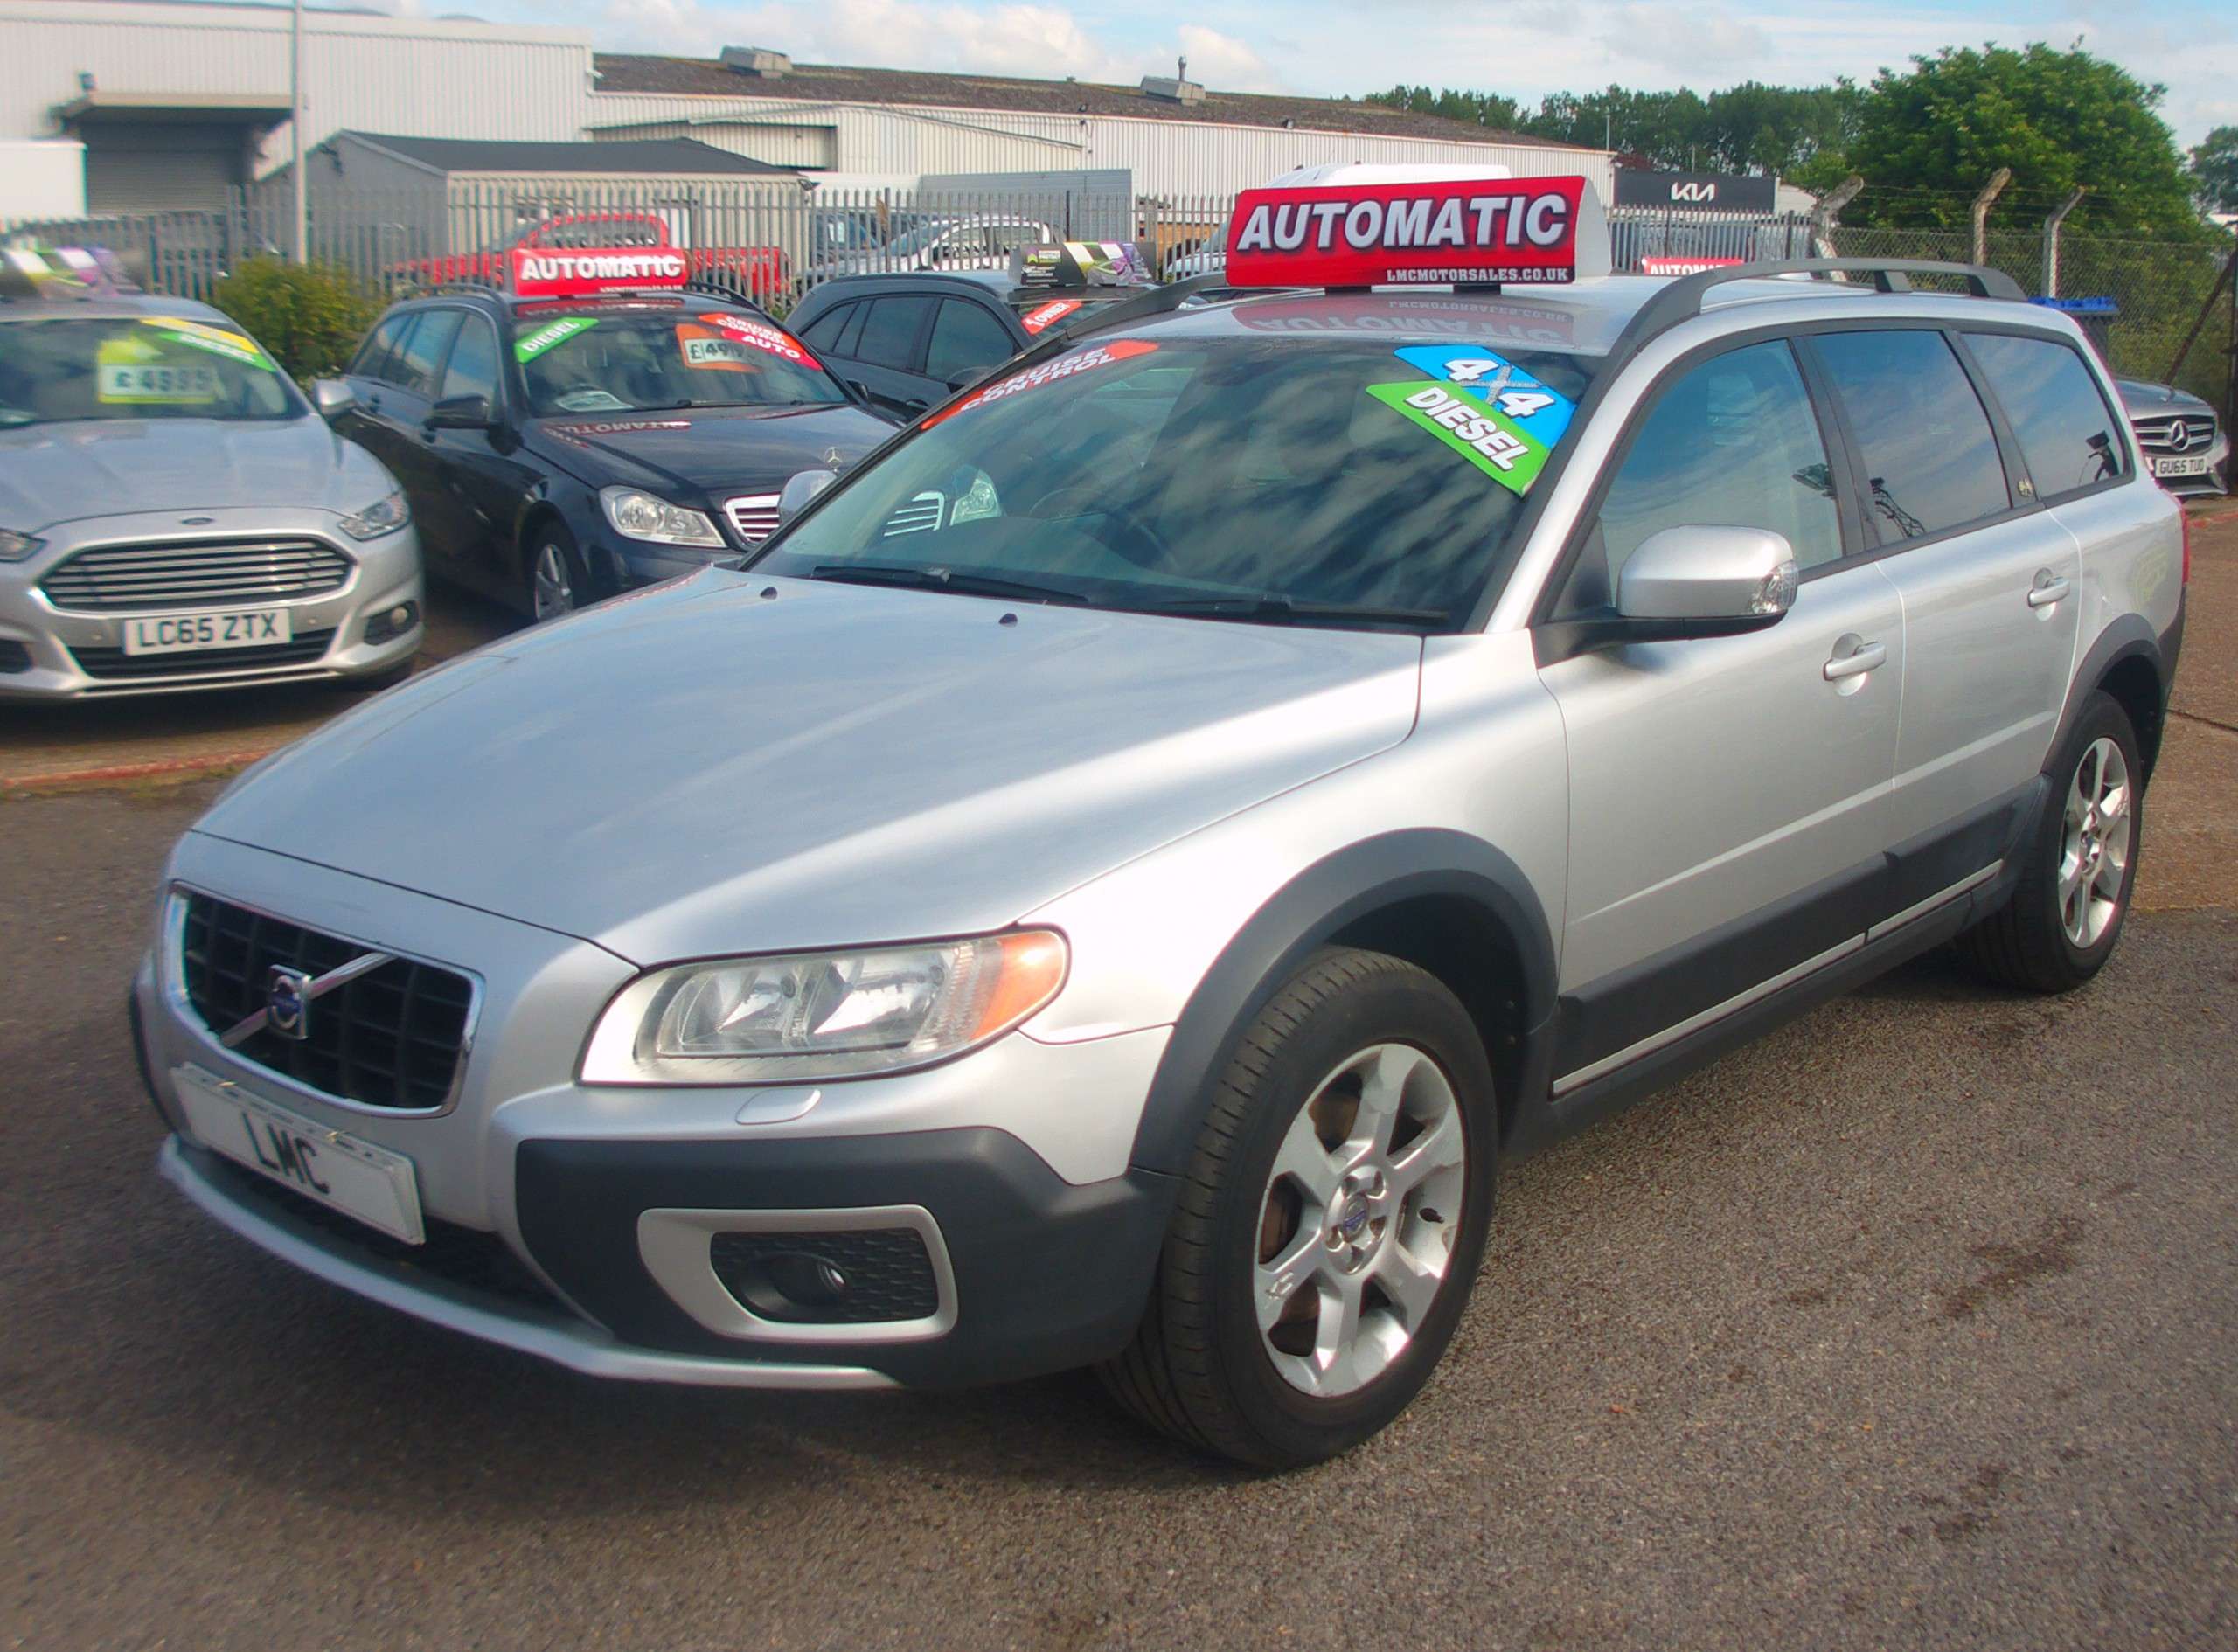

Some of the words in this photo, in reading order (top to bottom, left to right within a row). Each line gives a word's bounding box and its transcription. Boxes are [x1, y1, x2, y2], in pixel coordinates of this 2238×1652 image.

[1670, 181, 1715, 202] KIA
[1236, 194, 1567, 251] AUTOMATIC
[520, 254, 682, 281] AUTOMATIC
[1386, 267, 1568, 281] LMCMOTORSALES.CO.UK
[522, 321, 580, 351] DIESEL
[741, 335, 801, 359] AUTO
[960, 355, 1116, 412] CONTROL
[982, 347, 1106, 396] CRUISE
[1404, 385, 1530, 470] DIESEL
[136, 616, 215, 648] LC65
[222, 613, 279, 641] ZTX
[241, 1110, 330, 1196] LMC
